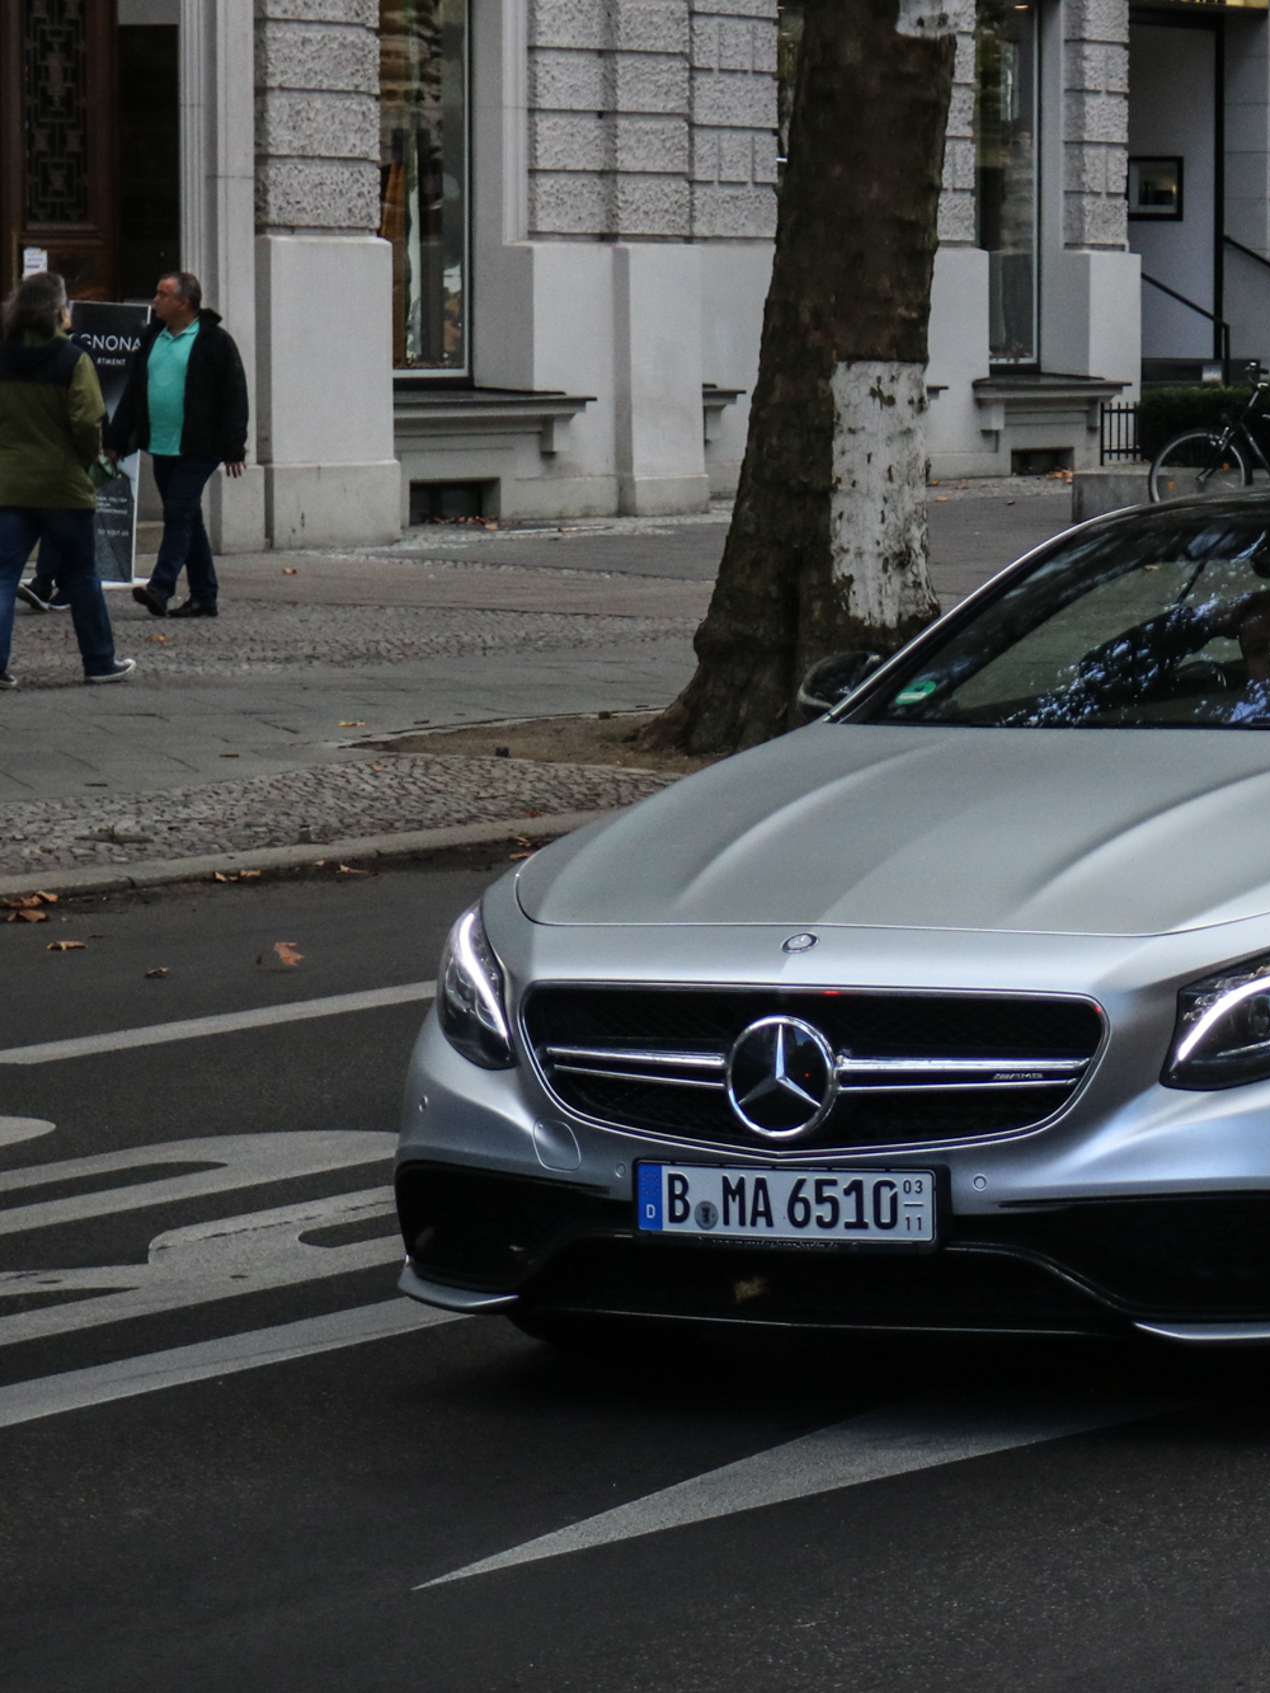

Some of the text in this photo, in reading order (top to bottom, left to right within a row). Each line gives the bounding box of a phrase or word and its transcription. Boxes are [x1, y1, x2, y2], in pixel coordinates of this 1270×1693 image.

[903, 1179, 923, 1194] 03
[646, 1173, 899, 1229] D B MA 6510
[904, 1215, 922, 1231] 11
